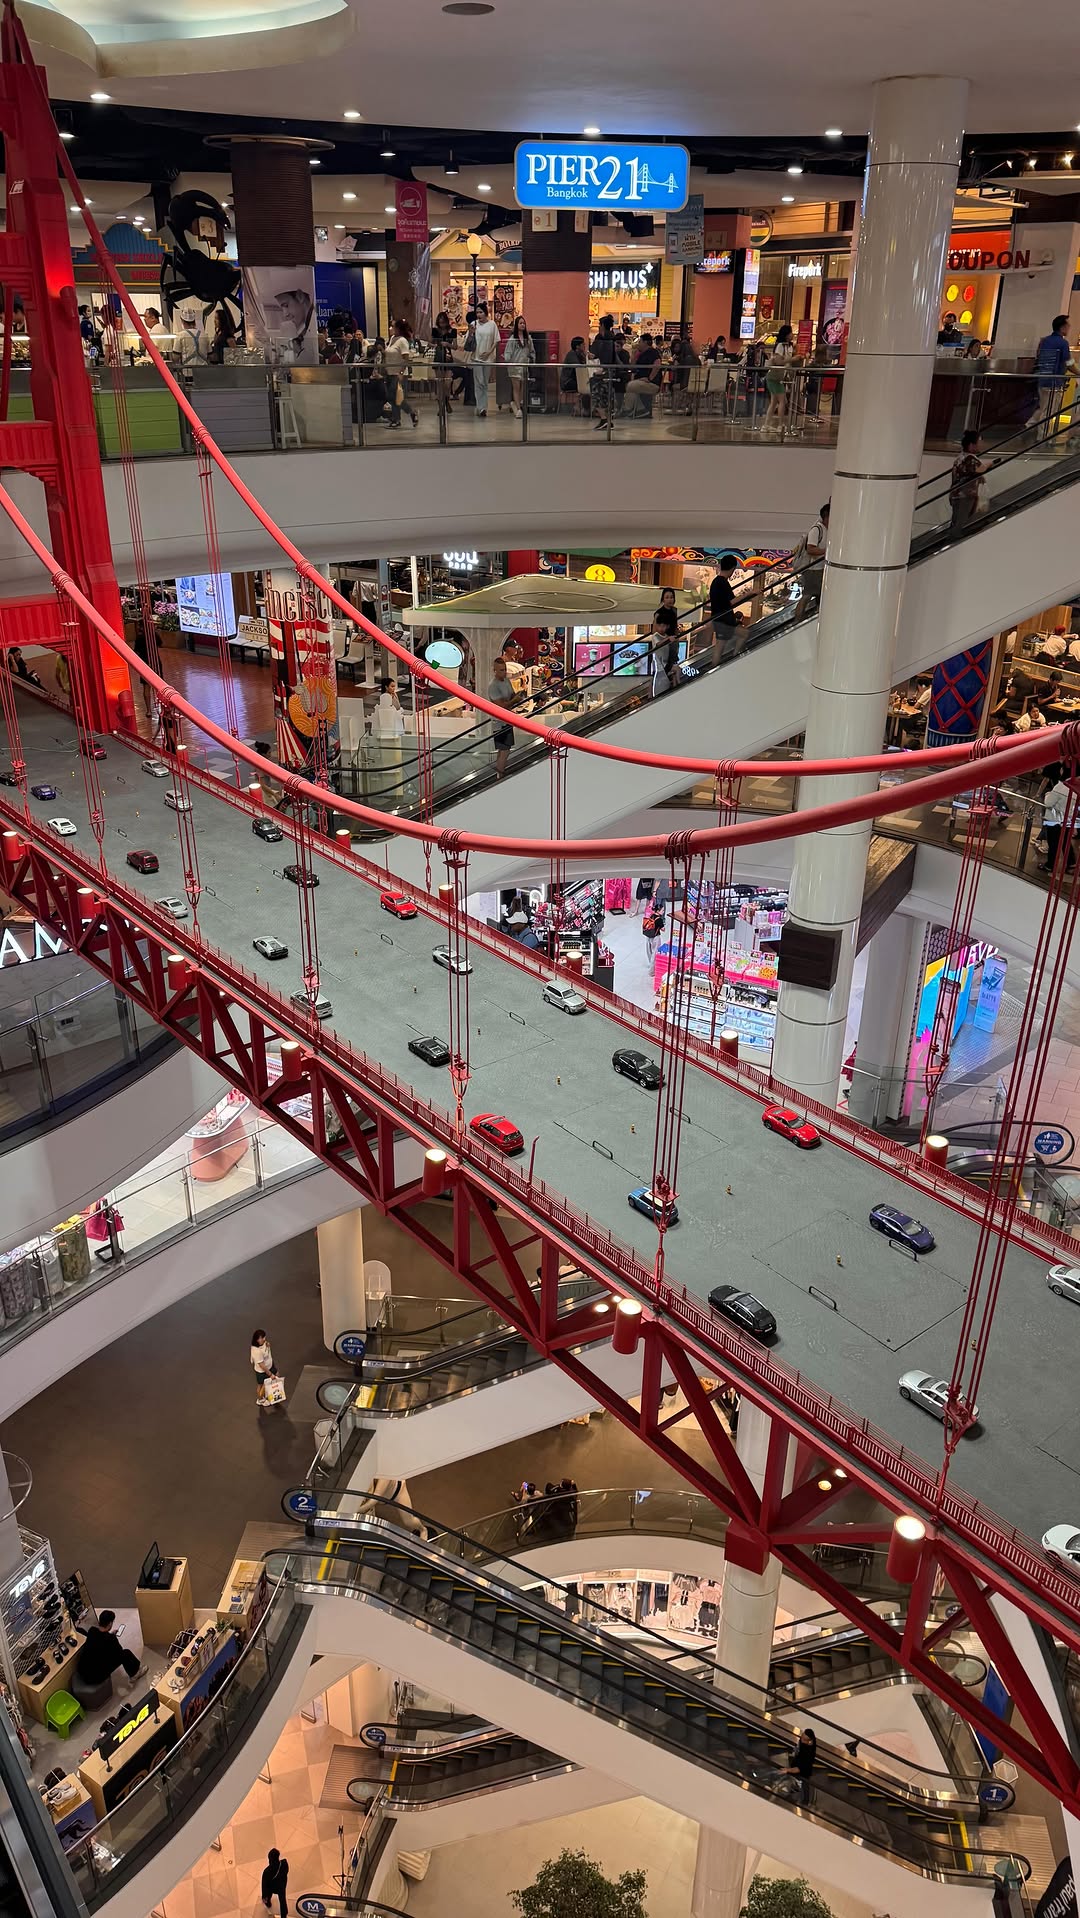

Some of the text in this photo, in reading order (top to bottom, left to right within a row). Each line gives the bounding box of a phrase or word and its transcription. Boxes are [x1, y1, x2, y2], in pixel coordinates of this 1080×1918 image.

[547, 187, 588, 200] Bangkok
[696, 255, 731, 267] repork
[948, 250, 1031, 270] OUPON
[612, 269, 648, 289] PLUS
[297, 1496, 309, 1508] 2
[989, 1788, 998, 1799] 1
[306, 1901, 319, 1911] M
